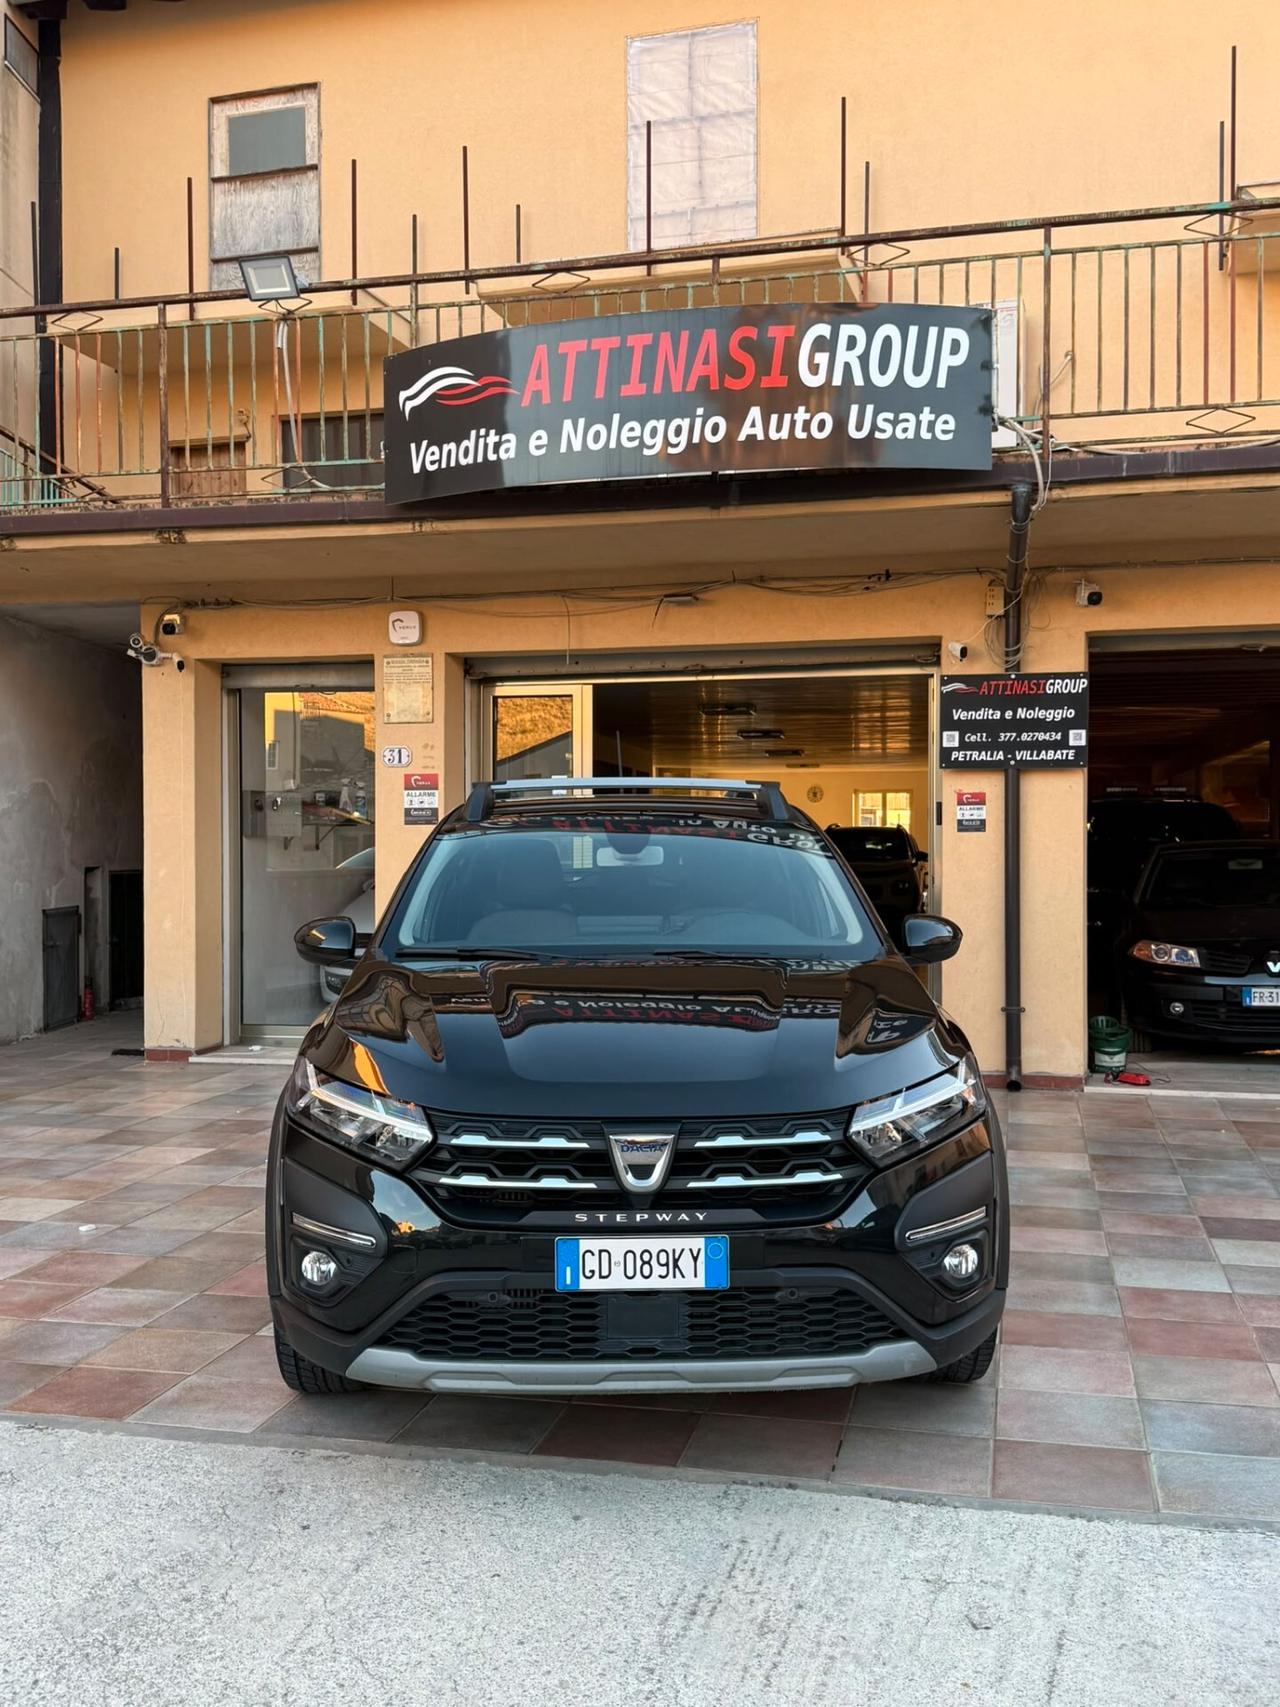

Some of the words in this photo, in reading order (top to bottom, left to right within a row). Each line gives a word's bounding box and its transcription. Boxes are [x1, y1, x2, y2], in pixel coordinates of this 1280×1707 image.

[410, 428, 517, 474] Vendita
[528, 429, 548, 457] e
[559, 407, 727, 456] Noleggio
[738, 405, 834, 441] Auto
[847, 404, 956, 441] Usate
[952, 708, 1001, 721] Vendita
[1004, 711, 1013, 720] e
[1016, 706, 1076, 722] Noleggio
[964, 732, 992, 742] Cell.
[998, 731, 1062, 742] 377.0270434
[387, 749, 402, 764] 31
[951, 750, 1005, 761] PETRALIA
[1015, 749, 1076, 761] VILLABATE
[620, 1144, 664, 1152] DACIA
[574, 1212, 707, 1223] STEPWAY
